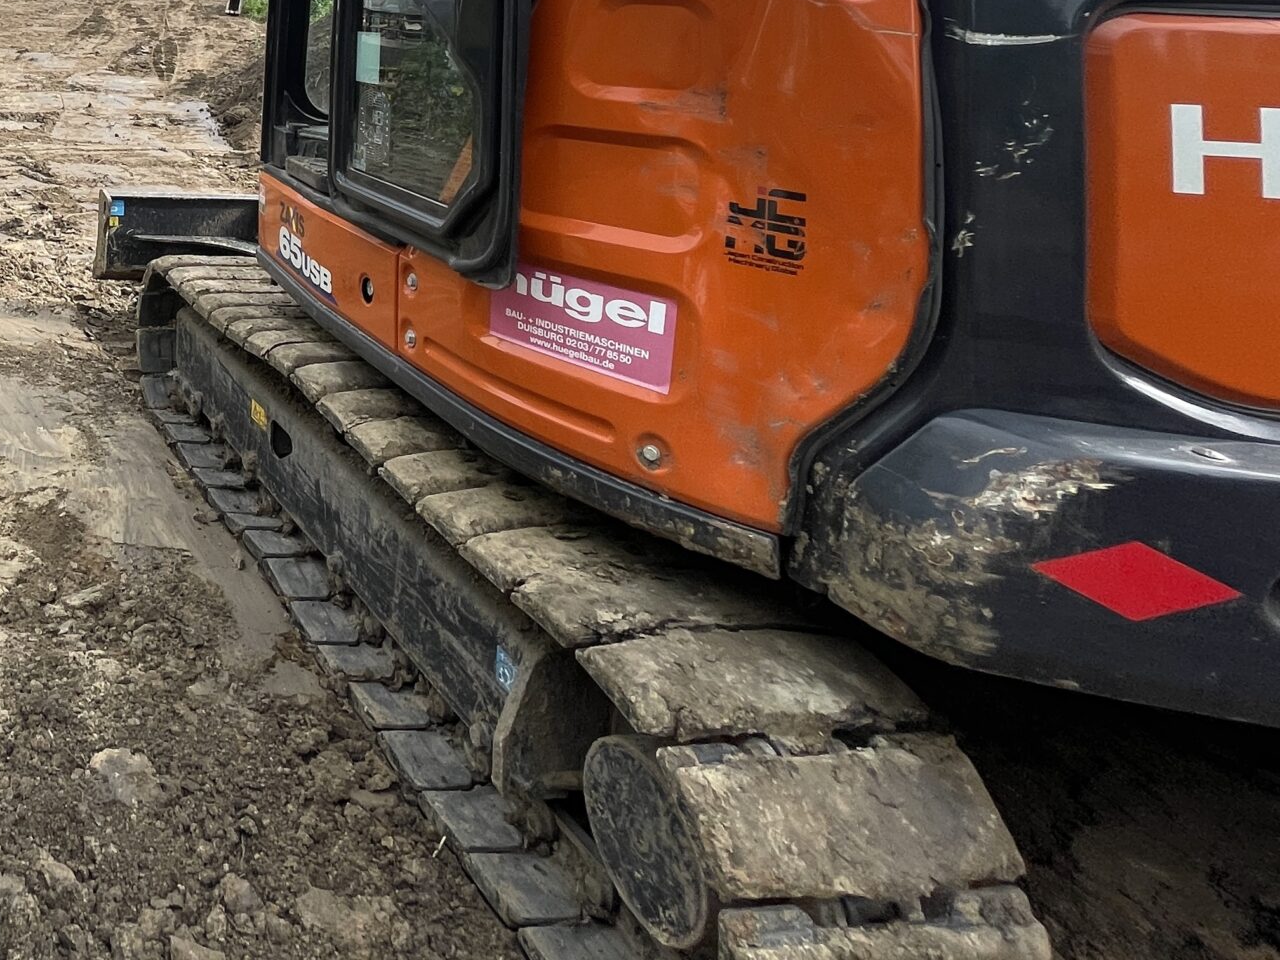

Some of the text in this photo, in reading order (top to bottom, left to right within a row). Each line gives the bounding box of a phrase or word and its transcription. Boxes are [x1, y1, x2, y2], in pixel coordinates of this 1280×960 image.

[505, 307, 527, 320] BAU-
[535, 317, 650, 360] INDUSTRIEMASCHINEN
[517, 321, 564, 344] DUISBURG
[529, 335, 615, 370] www.huegelbau.de
